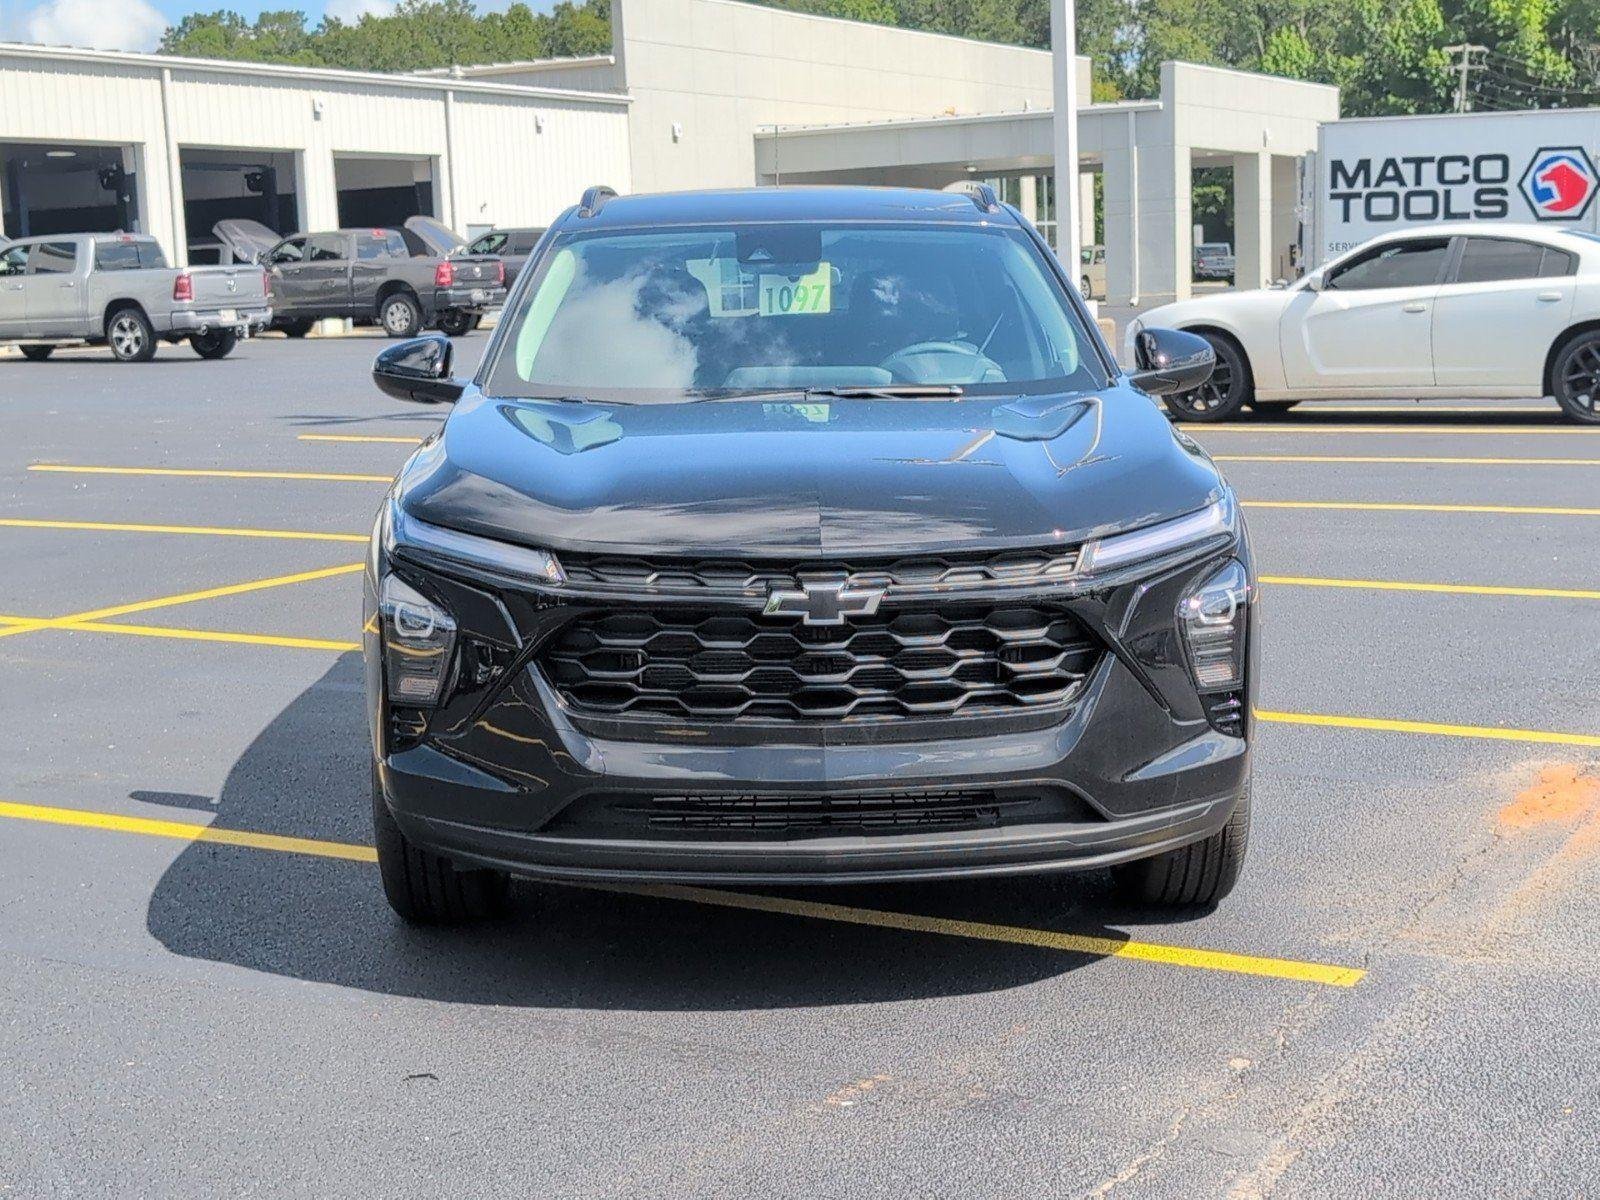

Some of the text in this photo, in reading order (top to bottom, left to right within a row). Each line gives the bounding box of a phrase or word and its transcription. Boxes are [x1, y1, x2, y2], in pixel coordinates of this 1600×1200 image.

[1330, 153, 1509, 189] MATCO
[1329, 187, 1509, 223] TOOLS
[765, 284, 825, 313] 1097
